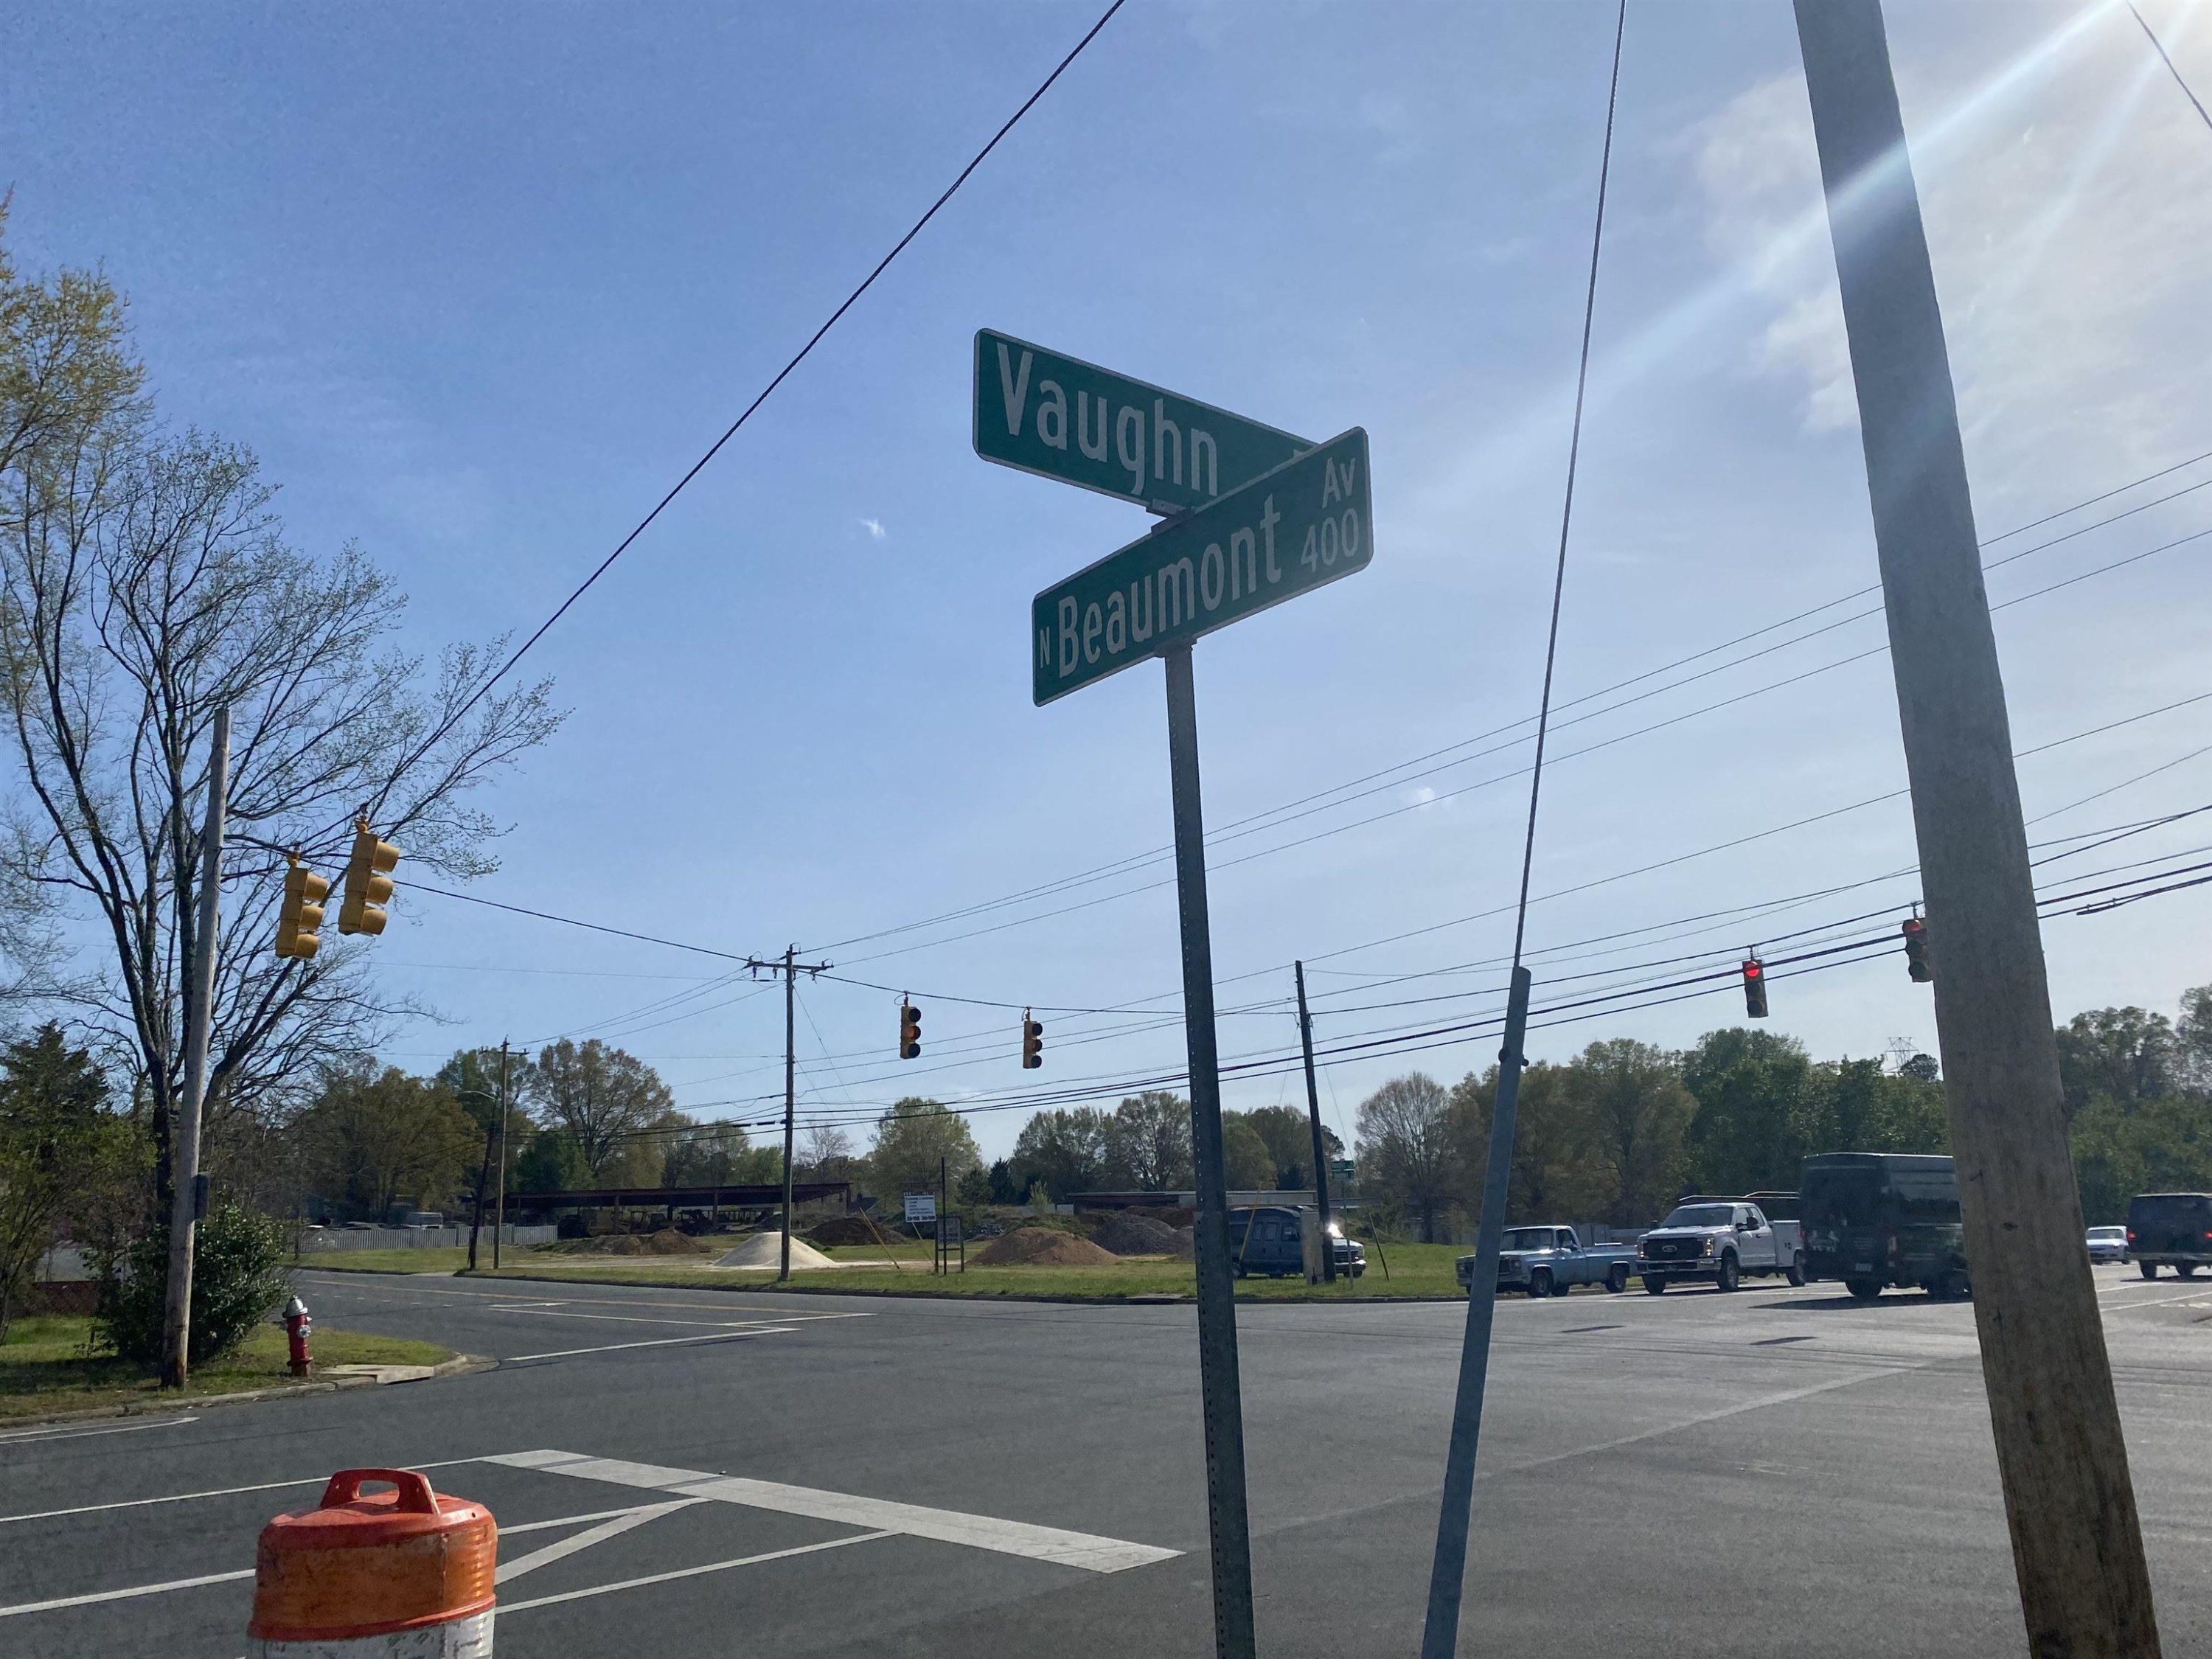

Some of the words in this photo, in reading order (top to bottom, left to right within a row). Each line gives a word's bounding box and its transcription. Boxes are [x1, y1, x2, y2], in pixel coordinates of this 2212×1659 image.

[996, 343, 1218, 497] Vaughn
[1040, 625, 1050, 669] N
[1058, 493, 1281, 678] Beaumont
[1301, 507, 1359, 573] 400
